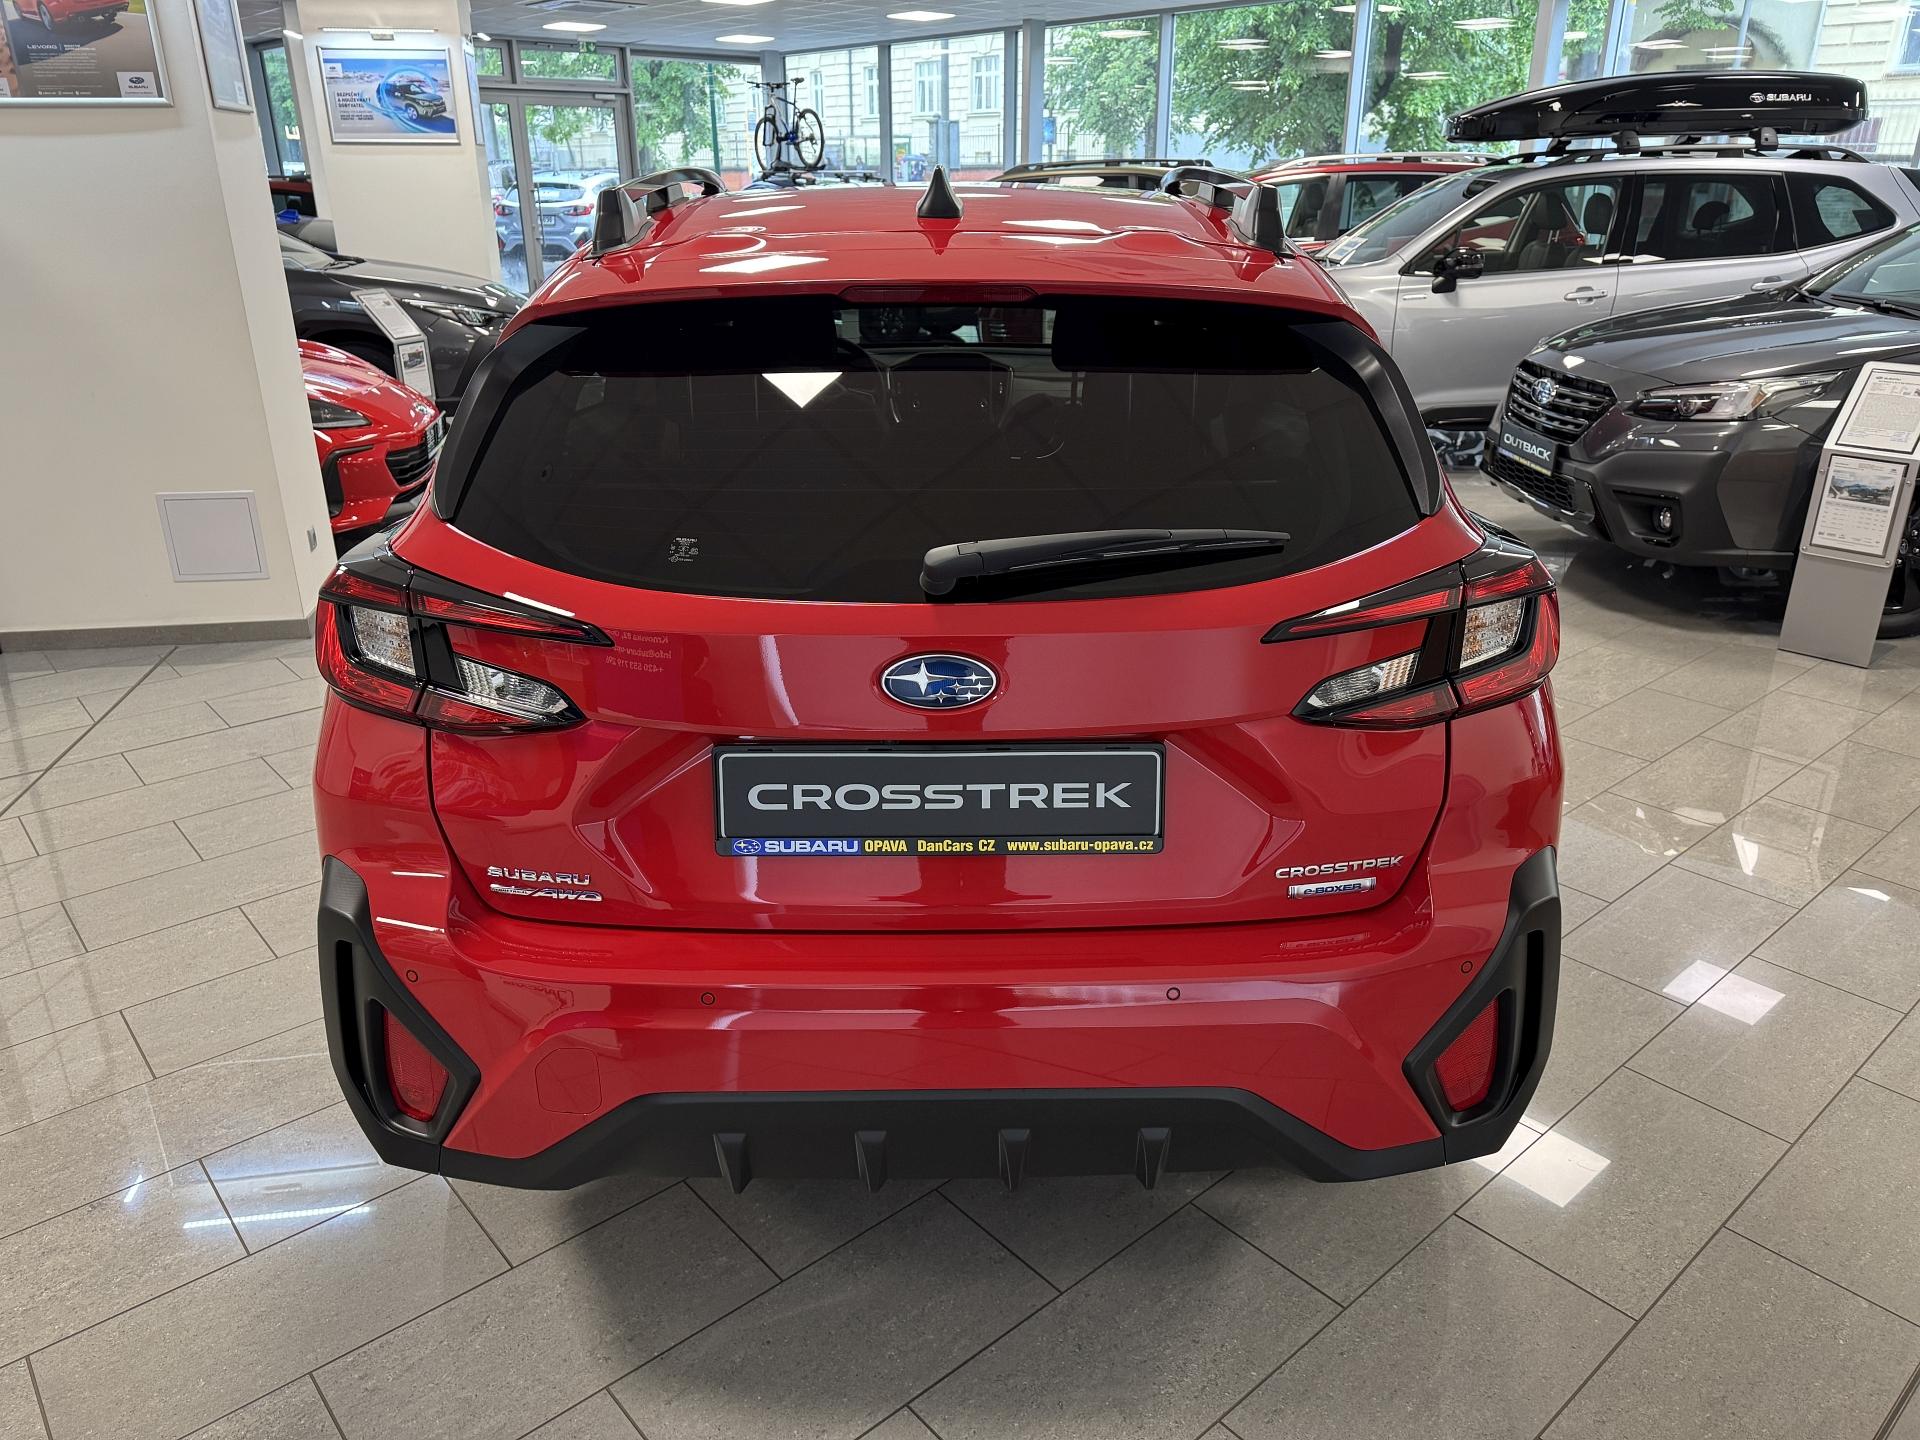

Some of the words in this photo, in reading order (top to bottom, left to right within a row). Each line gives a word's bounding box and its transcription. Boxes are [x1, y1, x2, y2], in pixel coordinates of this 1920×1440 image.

[1766, 93, 1812, 102] SUBARU
[1504, 434, 1551, 461] OUTBACK
[748, 782, 1133, 811] CROSSTREK
[764, 840, 860, 853] SUBARU
[864, 839, 908, 853] OPAVA
[917, 839, 974, 853] DanCars
[978, 839, 996, 852] CZ
[1007, 838, 1155, 853] www.subaru-opava.cz
[487, 865, 591, 886] SUBARU
[1275, 855, 1405, 880] CROSSTREK
[532, 888, 602, 901] AWD
[1303, 882, 1363, 895] e-BOXER
